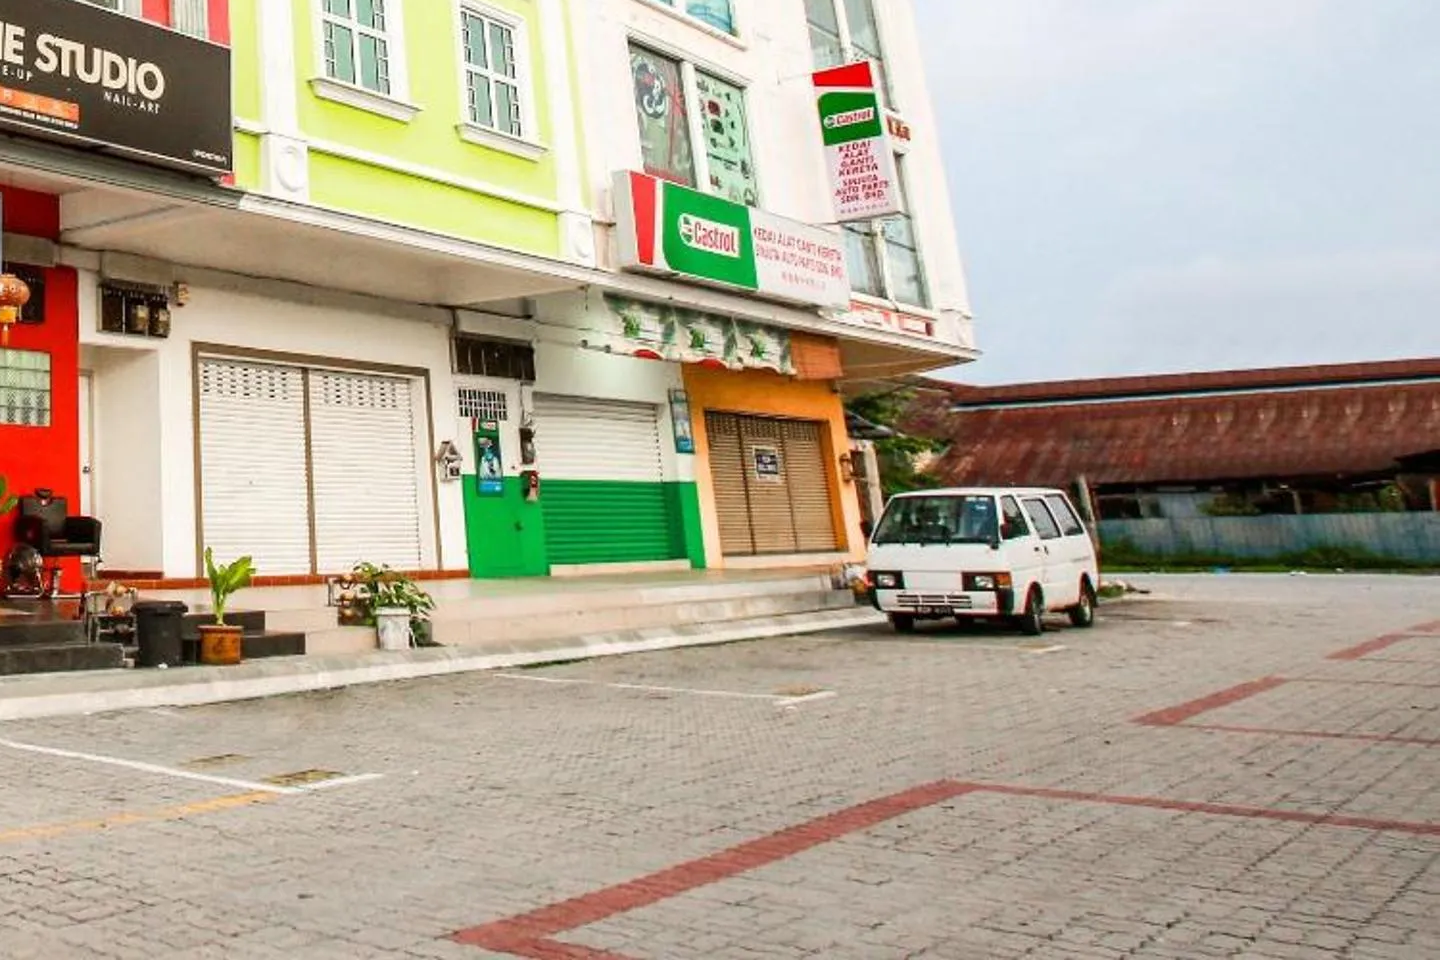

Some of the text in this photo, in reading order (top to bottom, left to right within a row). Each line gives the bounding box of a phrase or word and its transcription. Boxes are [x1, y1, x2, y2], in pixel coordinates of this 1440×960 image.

[34, 33, 166, 101] STUDIO
[103, 90, 162, 116] NAIL-ART
[837, 109, 871, 124] Castrol
[692, 220, 738, 254] Castrol
